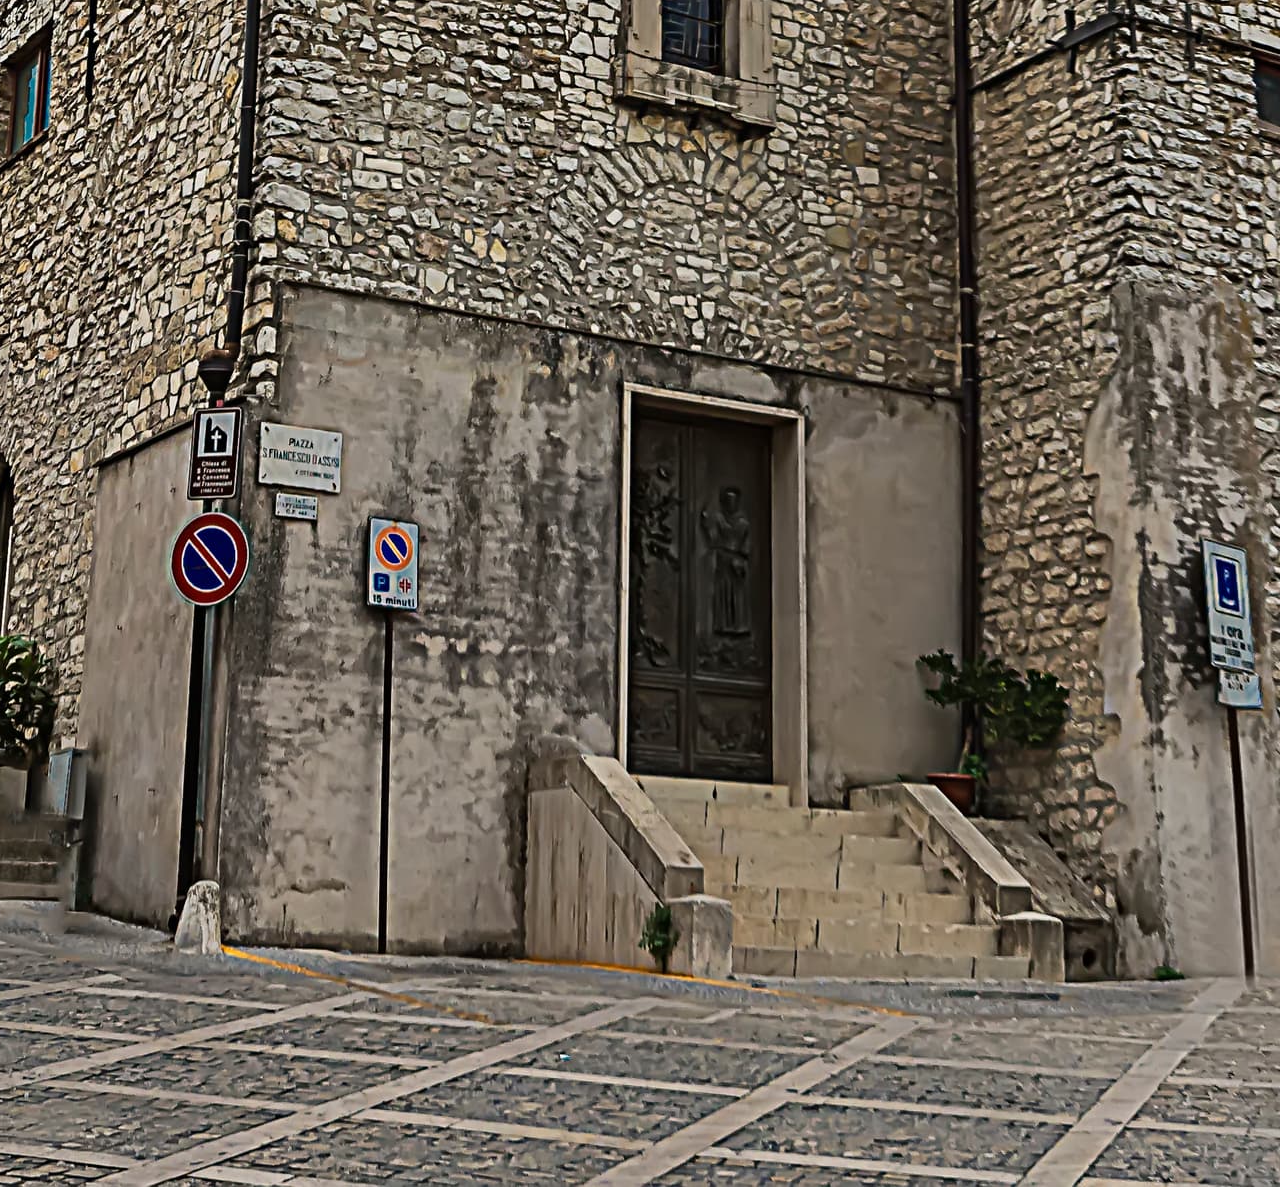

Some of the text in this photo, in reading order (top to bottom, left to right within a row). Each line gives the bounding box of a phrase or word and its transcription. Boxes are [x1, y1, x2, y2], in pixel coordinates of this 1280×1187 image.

[288, 437, 314, 450] PIAZZA
[268, 448, 311, 465] FRANCESCO
[372, 594, 415, 608] 15 minuti
[1226, 625, 1244, 640] ora
